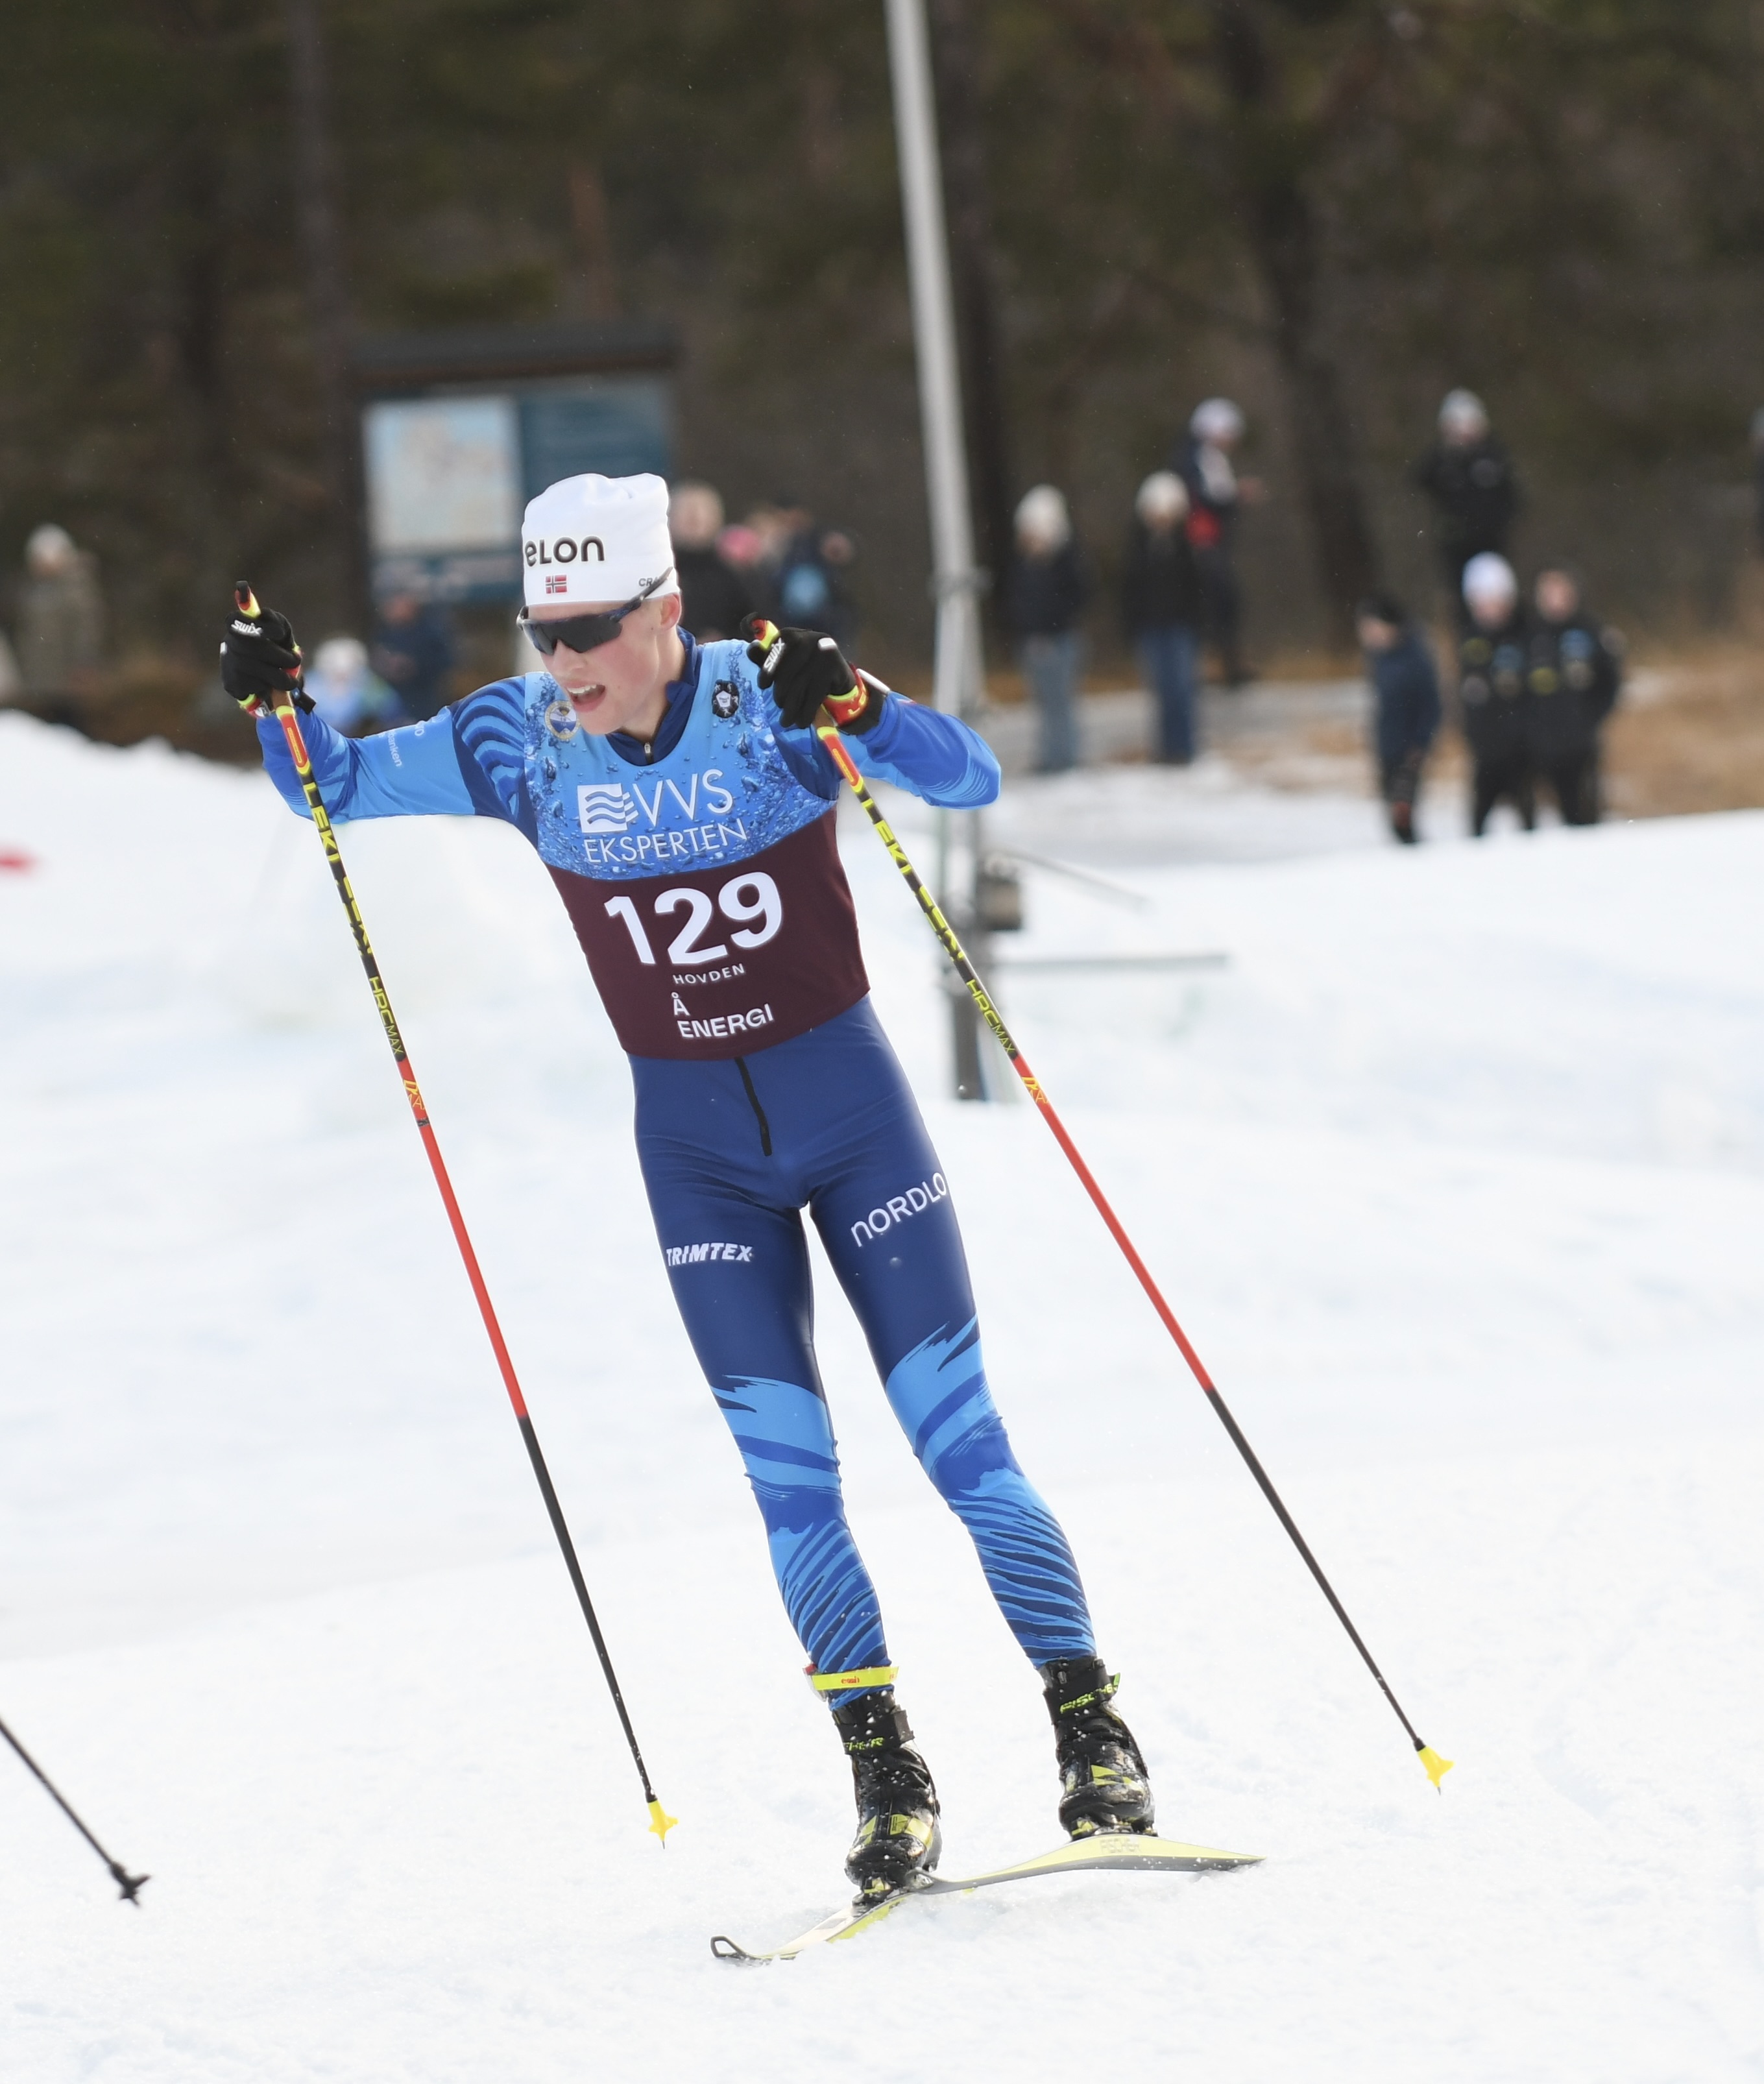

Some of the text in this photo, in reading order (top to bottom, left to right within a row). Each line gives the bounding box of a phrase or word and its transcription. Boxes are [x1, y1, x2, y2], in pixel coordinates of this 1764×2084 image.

[387, 729, 403, 767] banken
[632, 768, 734, 827] VVS
[303, 782, 341, 862] LEKI
[583, 818, 747, 863] EKSPERTEN
[862, 798, 912, 874] LEKI
[604, 871, 782, 965] 129
[672, 963, 745, 984] HOVDEN
[671, 991, 690, 1016] Å
[677, 1003, 774, 1038] ENERGI
[666, 1242, 752, 1266] TRIMTEX
